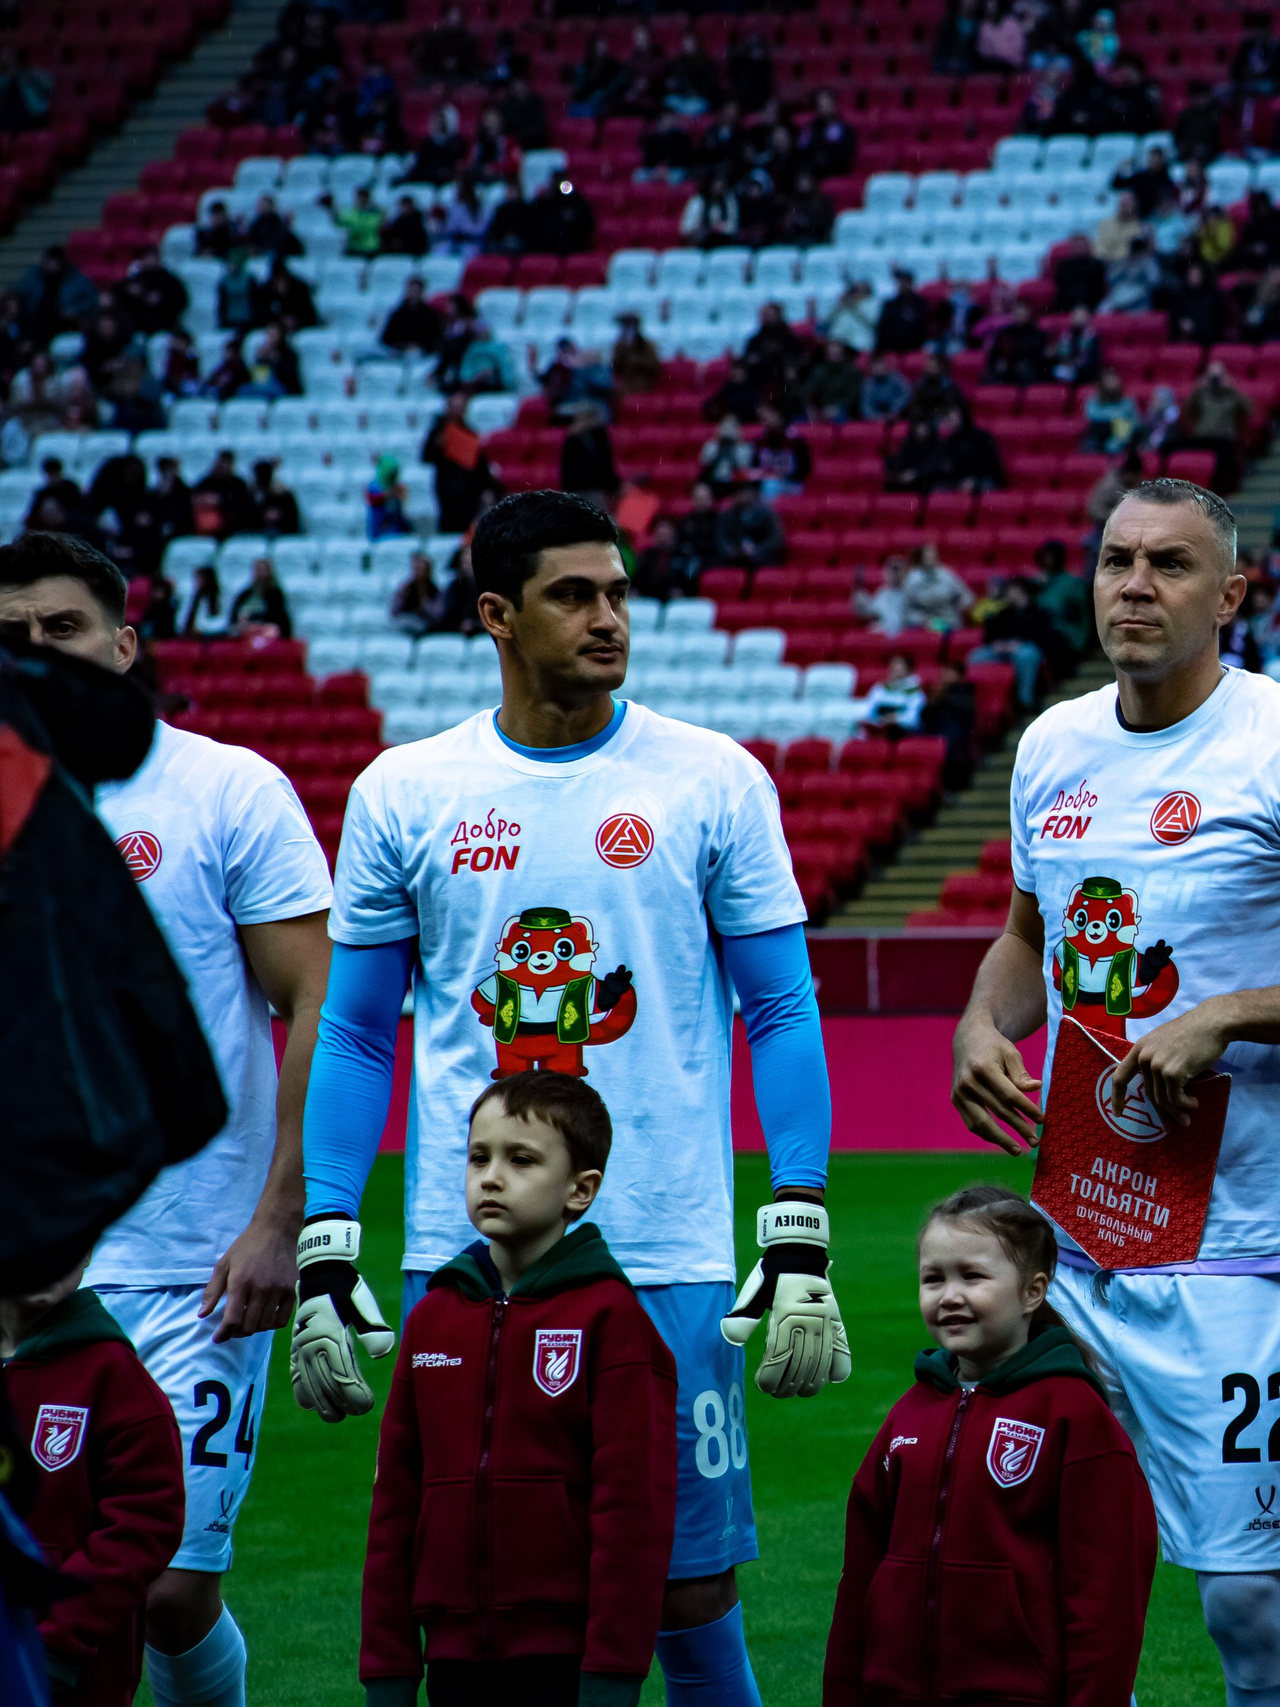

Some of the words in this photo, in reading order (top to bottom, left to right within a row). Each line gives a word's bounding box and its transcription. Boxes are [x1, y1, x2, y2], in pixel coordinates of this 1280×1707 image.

[1049, 779, 1098, 813] Добро
[451, 808, 521, 846] Добро
[1040, 815, 1092, 839] FON
[451, 846, 520, 875] FON
[1090, 1157, 1158, 1197] АКРОН
[1070, 1173, 1170, 1228] ТОЛЬЯТТИ
[775, 1215, 820, 1230] GUDIEV
[1076, 1205, 1153, 1243] ФУТБОЛЬНЫЙ
[1097, 1227, 1126, 1247] КЛУБ
[539, 1333, 580, 1343] РУБИН
[190, 1380, 255, 1471] 24
[693, 1382, 747, 1479] 88
[997, 1421, 1042, 1440] РУБИН
